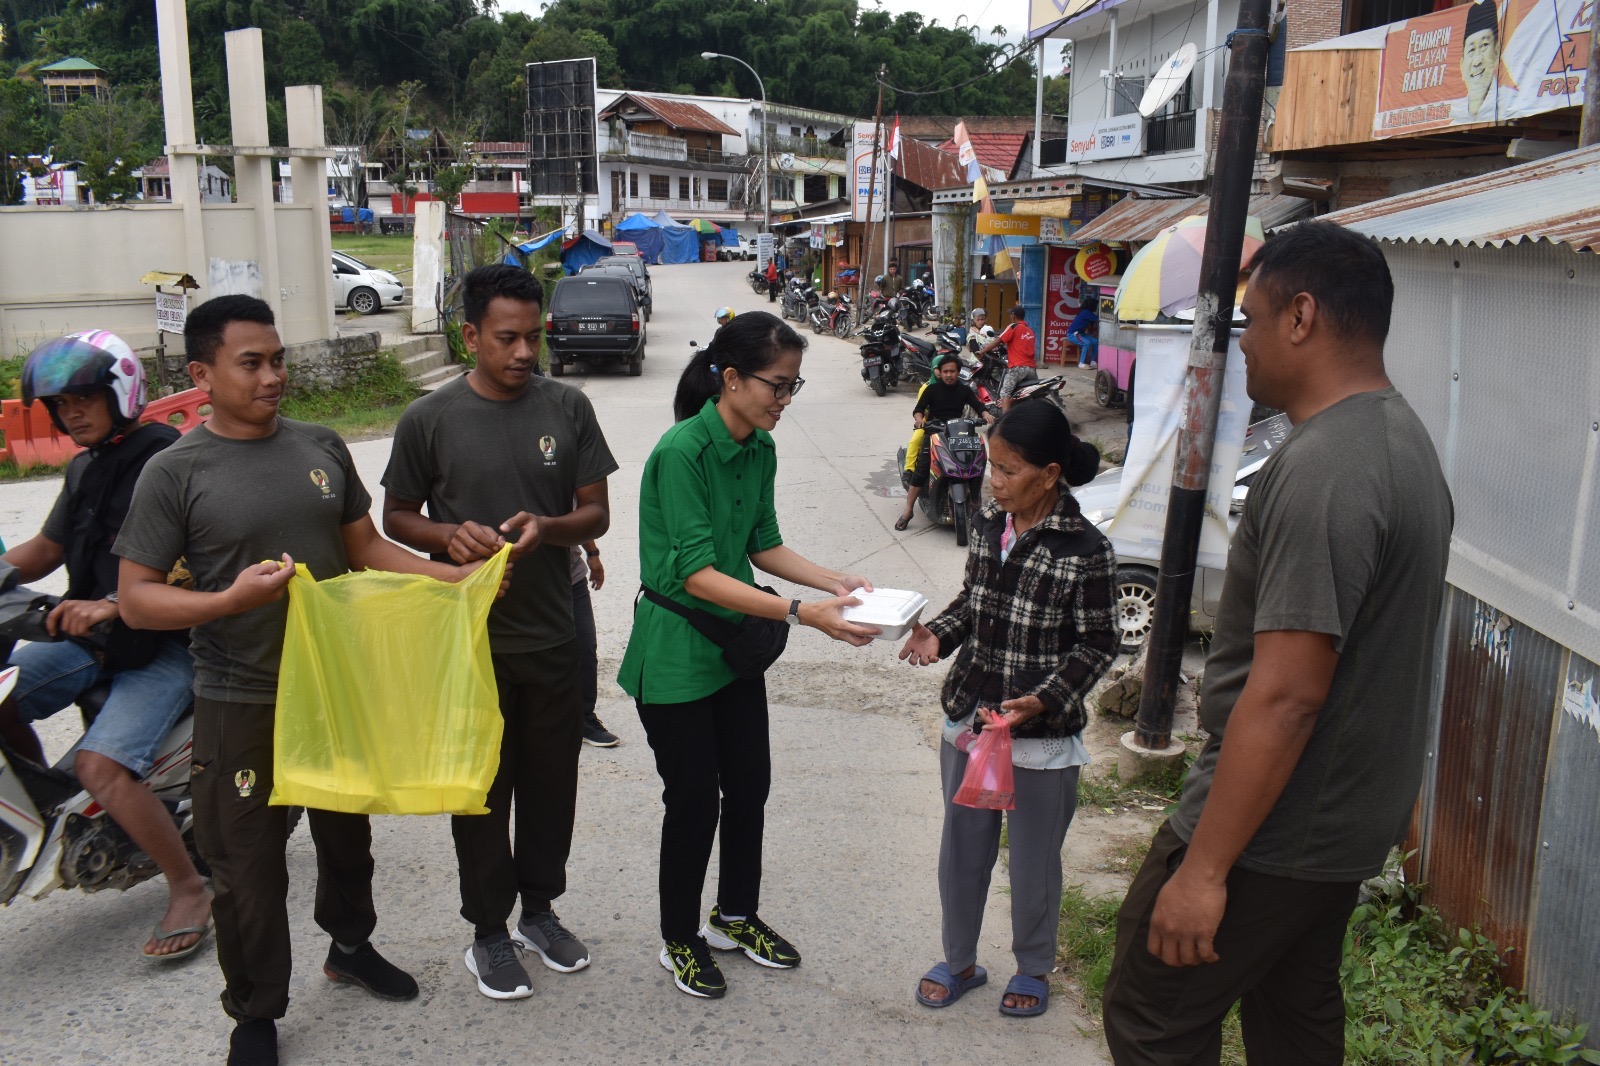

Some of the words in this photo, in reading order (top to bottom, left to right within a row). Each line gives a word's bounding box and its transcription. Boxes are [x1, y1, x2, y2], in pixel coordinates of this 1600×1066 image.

[1407, 26, 1452, 60] PEMIMPIN
[1408, 47, 1448, 70] PELAYAN
[1402, 63, 1447, 93] RAKYAT
[1537, 76, 1580, 98] FOR
[866, 166, 879, 174] BI
[989, 218, 1029, 229] realme
